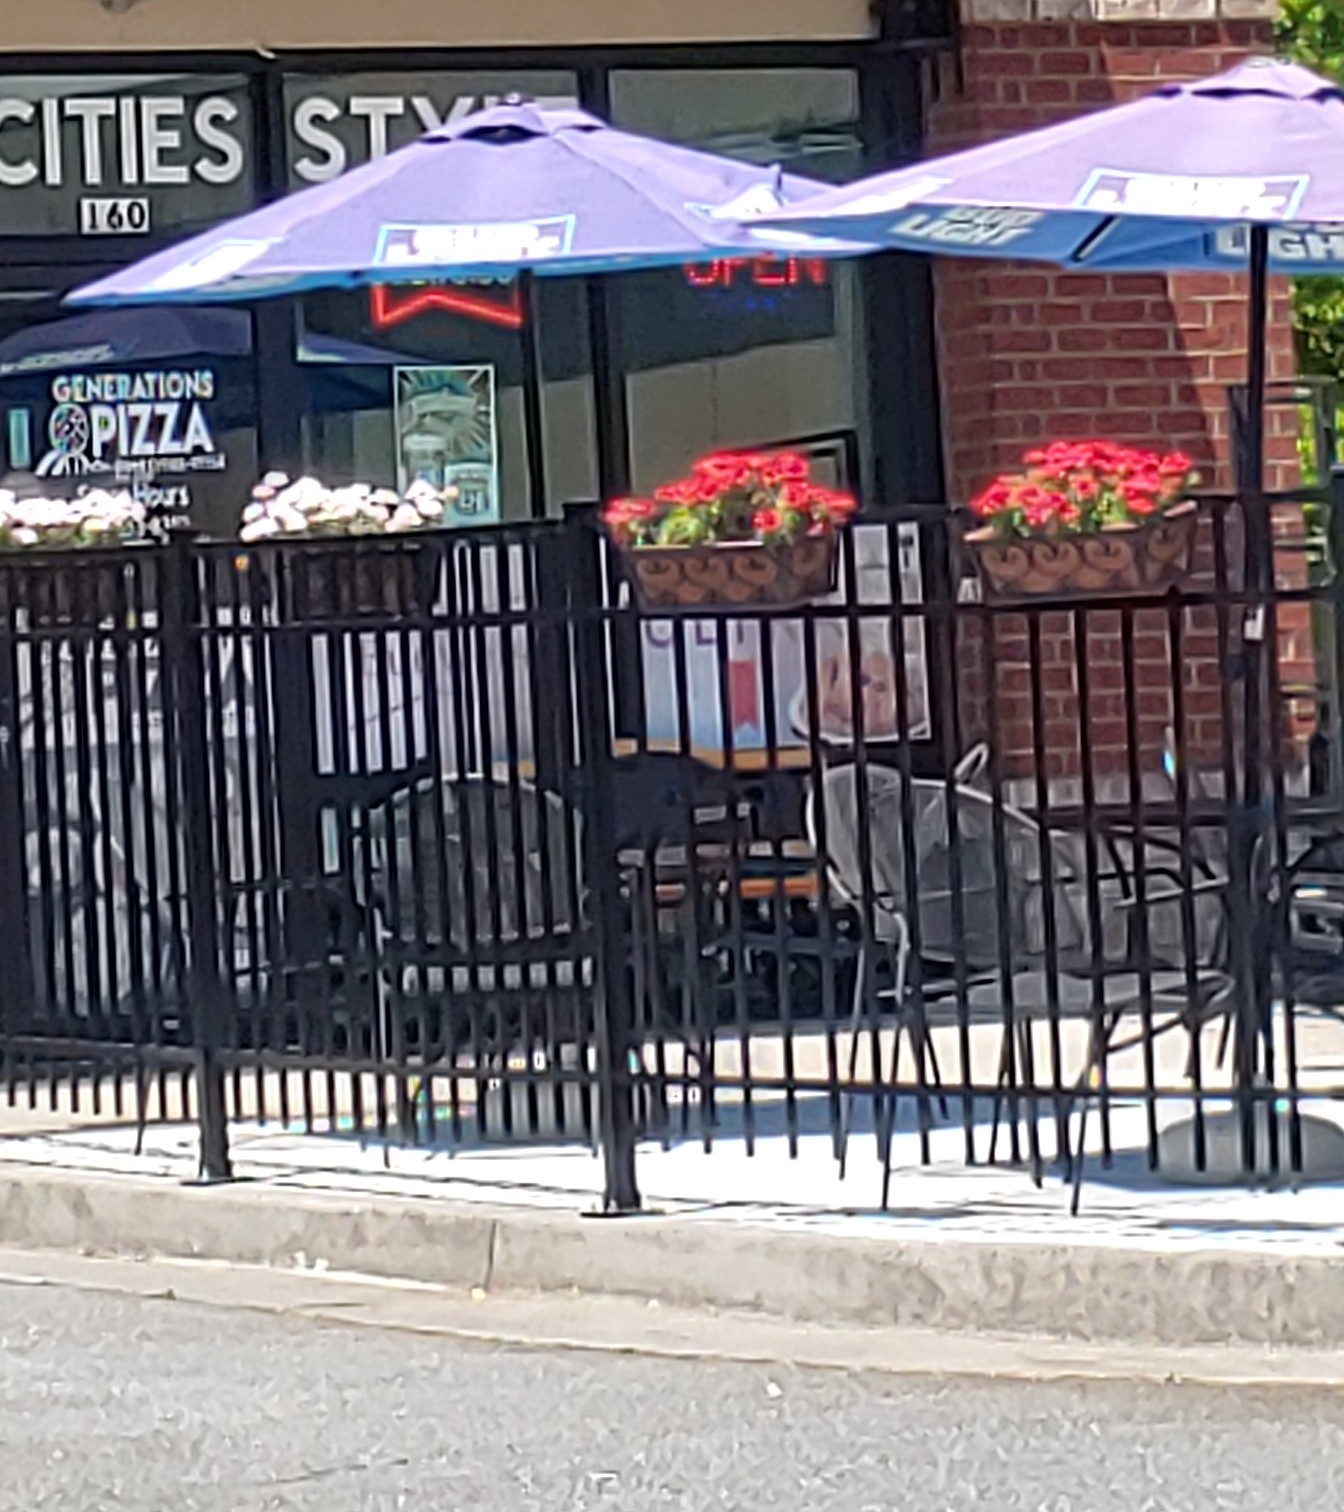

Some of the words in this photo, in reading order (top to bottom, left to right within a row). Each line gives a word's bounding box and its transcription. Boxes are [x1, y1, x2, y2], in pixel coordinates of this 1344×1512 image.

[87, 201, 146, 230] 160
[51, 370, 215, 403] GENERATIONS
[89, 401, 215, 458] PIZZA
